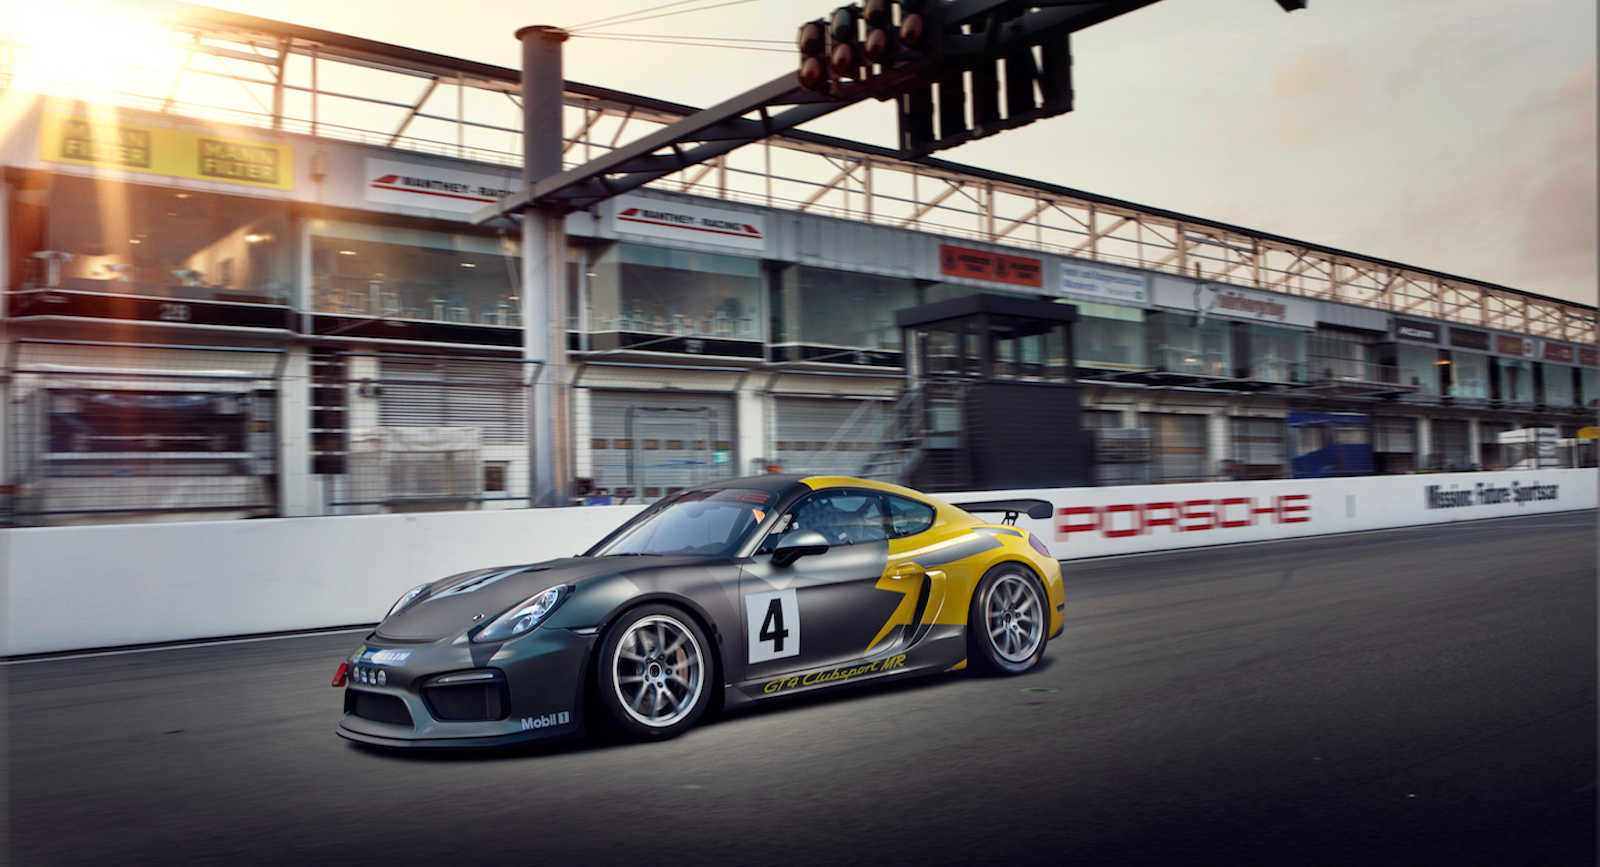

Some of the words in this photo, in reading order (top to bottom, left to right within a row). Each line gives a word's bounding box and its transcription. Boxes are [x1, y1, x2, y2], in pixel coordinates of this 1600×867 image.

[401, 176, 470, 194] MANTHEY
[641, 209, 695, 225] MANTHEY
[700, 218, 742, 232] RACING
[1512, 480, 1560, 506] Sportscar
[1055, 494, 1310, 541] PORSCHE
[760, 598, 788, 652] 4
[764, 676, 800, 693] GT4
[802, 660, 878, 686] Clubsport
[880, 654, 907, 671] MR
[521, 713, 556, 730] Mobil
